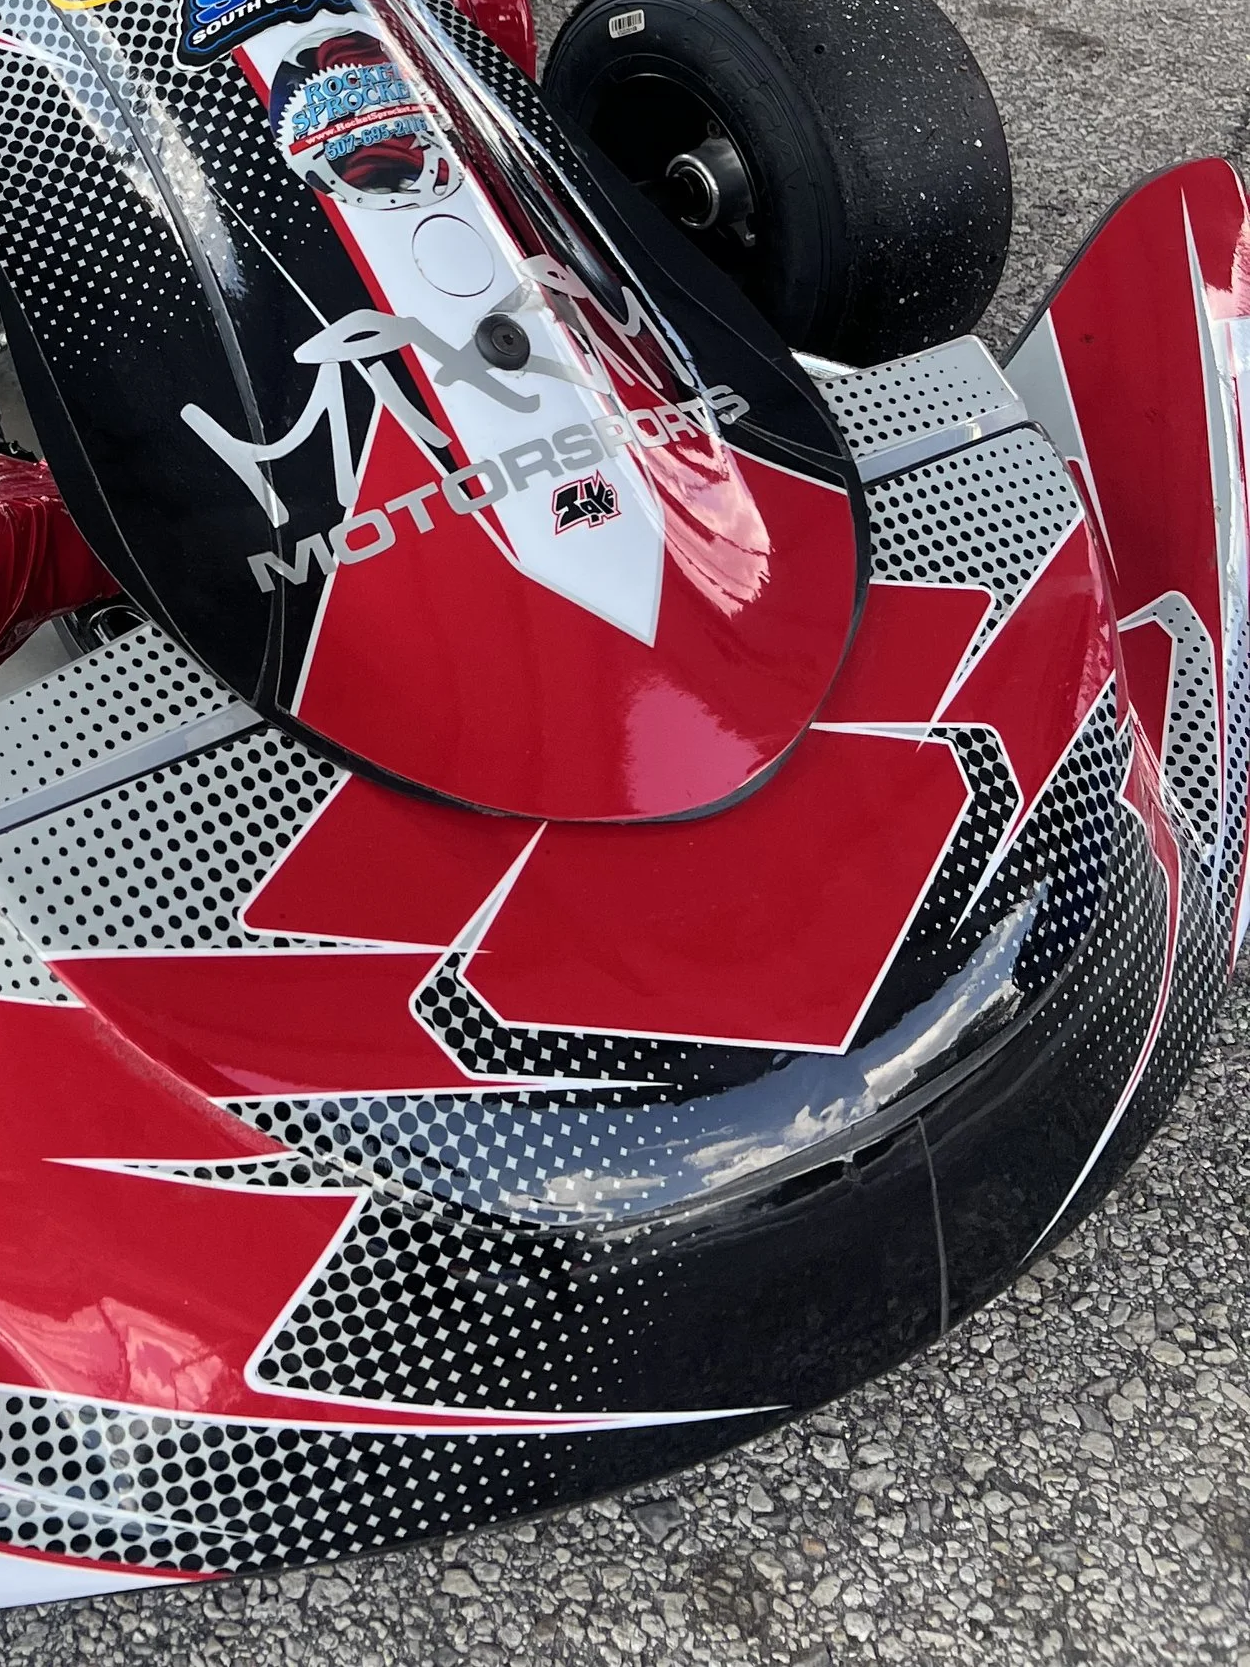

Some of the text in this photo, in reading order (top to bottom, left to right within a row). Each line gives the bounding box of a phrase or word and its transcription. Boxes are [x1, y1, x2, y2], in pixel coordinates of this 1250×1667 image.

[192, 0, 262, 46] SOUTH
[291, 79, 414, 135] SPROCKE
[246, 383, 751, 593] MOTORSPORTS
